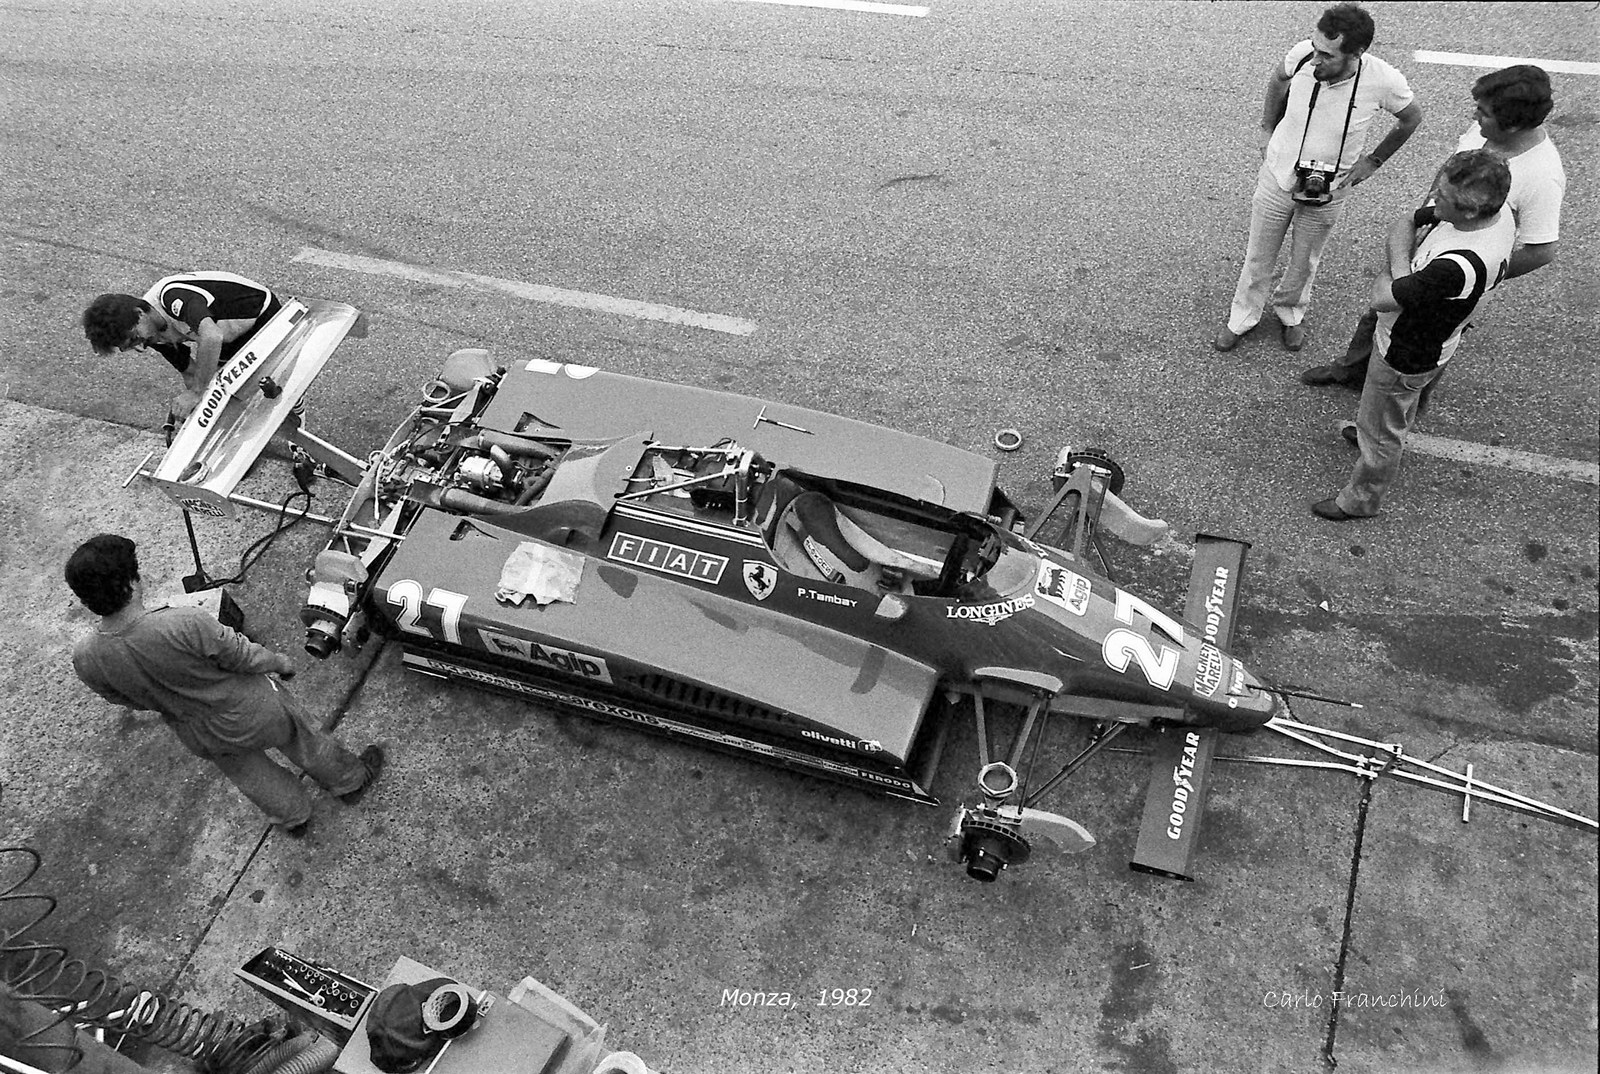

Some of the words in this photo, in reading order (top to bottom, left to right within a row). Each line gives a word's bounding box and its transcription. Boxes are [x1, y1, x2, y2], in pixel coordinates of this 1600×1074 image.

[197, 351, 258, 428] GOODYEAR
[617, 538, 720, 577] FIAT
[386, 579, 469, 645] 27
[946, 592, 1036, 619] LONGINES
[1069, 578, 1089, 611] Agip
[1203, 566, 1229, 644] OODYEAR
[530, 642, 602, 677] Agip
[1102, 587, 1184, 692] 27
[801, 730, 857, 749] olivetti
[1166, 732, 1200, 840] GOODYEAR
